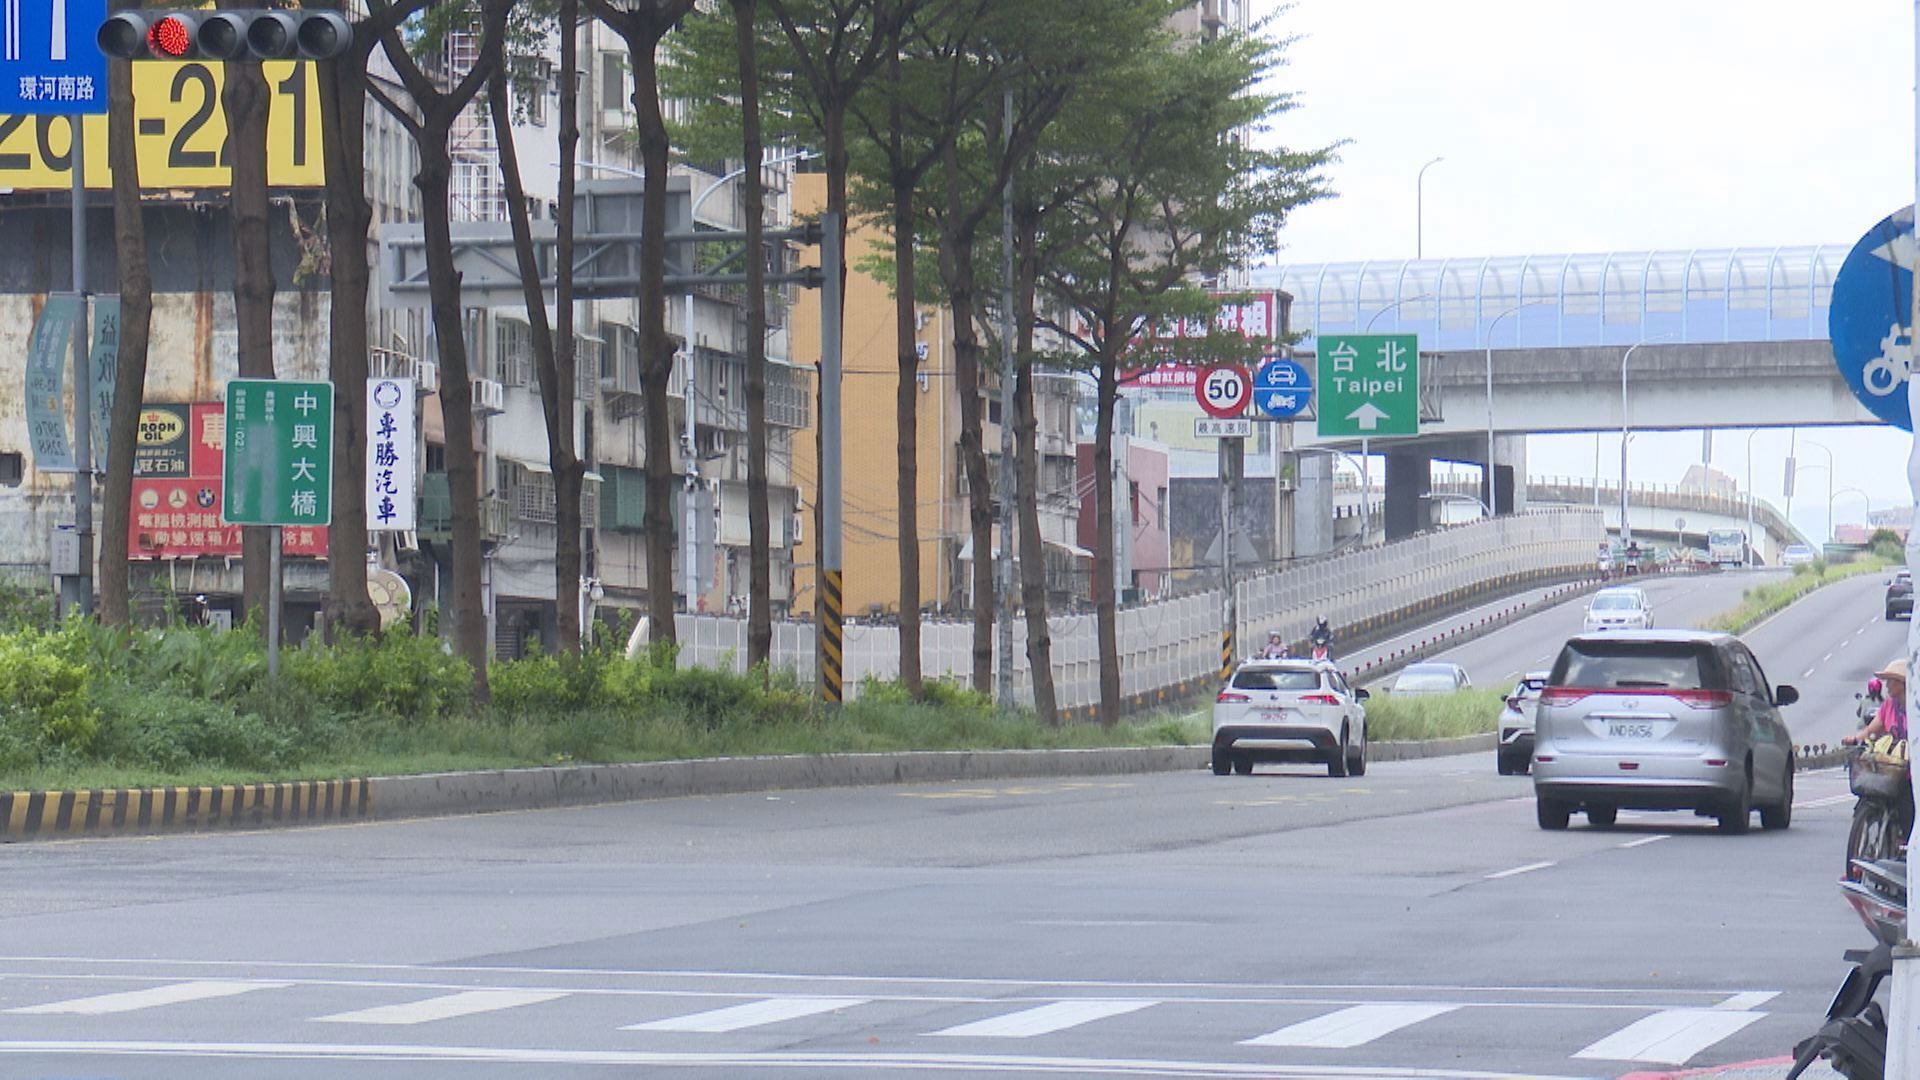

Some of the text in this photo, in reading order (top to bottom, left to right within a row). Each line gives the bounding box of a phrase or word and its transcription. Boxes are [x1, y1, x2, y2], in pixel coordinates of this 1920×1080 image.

[19, 75, 95, 101] 環河南路
[1328, 341, 1407, 373] 台北
[1208, 379, 1239, 400] 50
[1333, 377, 1403, 397] Taipei
[144, 432, 163, 440] OIL
[1198, 422, 1249, 434] 最高速限
[290, 389, 318, 517] 中興大橋
[375, 411, 400, 526] 專勝汽車
